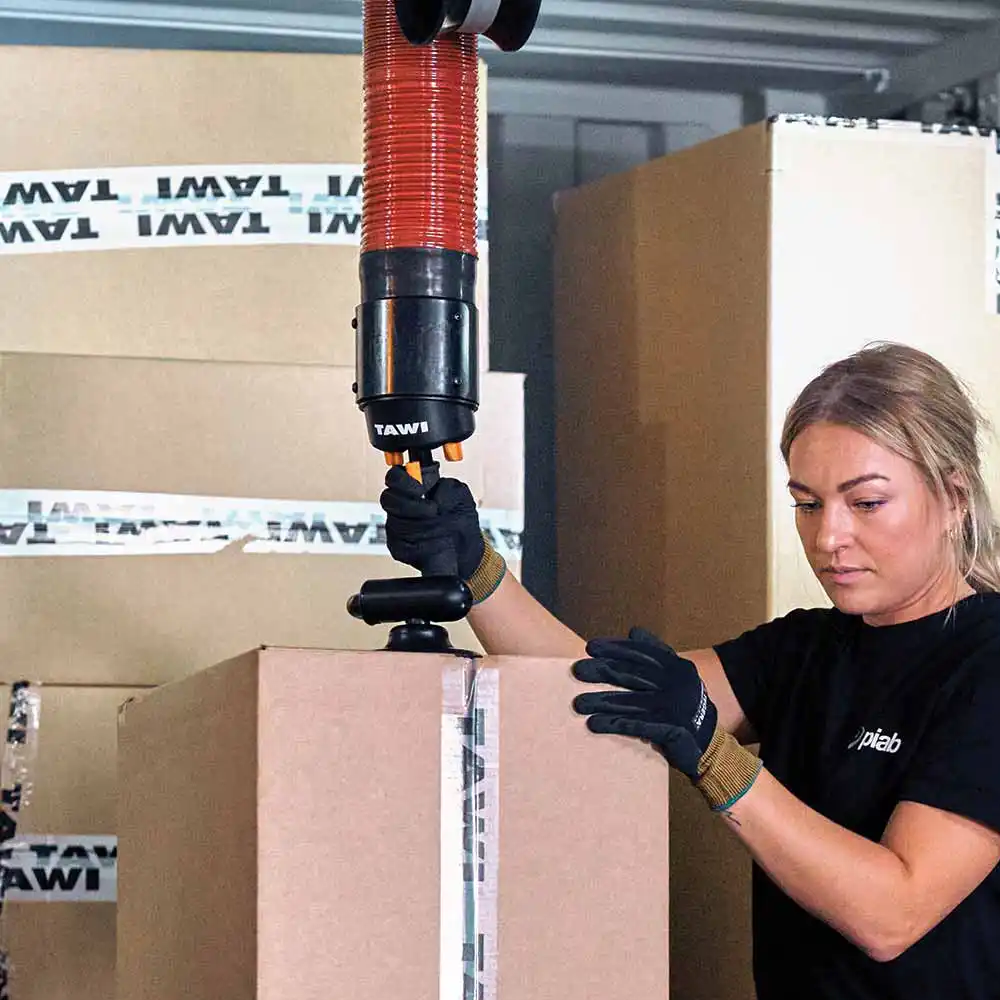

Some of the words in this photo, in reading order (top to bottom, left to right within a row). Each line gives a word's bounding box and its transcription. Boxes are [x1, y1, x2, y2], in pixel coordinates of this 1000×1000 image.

[2, 179, 119, 205] TAW
[157, 175, 290, 199] TAWI
[0, 217, 99, 243] TAW
[138, 211, 270, 237] TAWI
[374, 421, 429, 436] TAWI
[857, 727, 901, 753] piab
[0, 867, 99, 891] AWI
